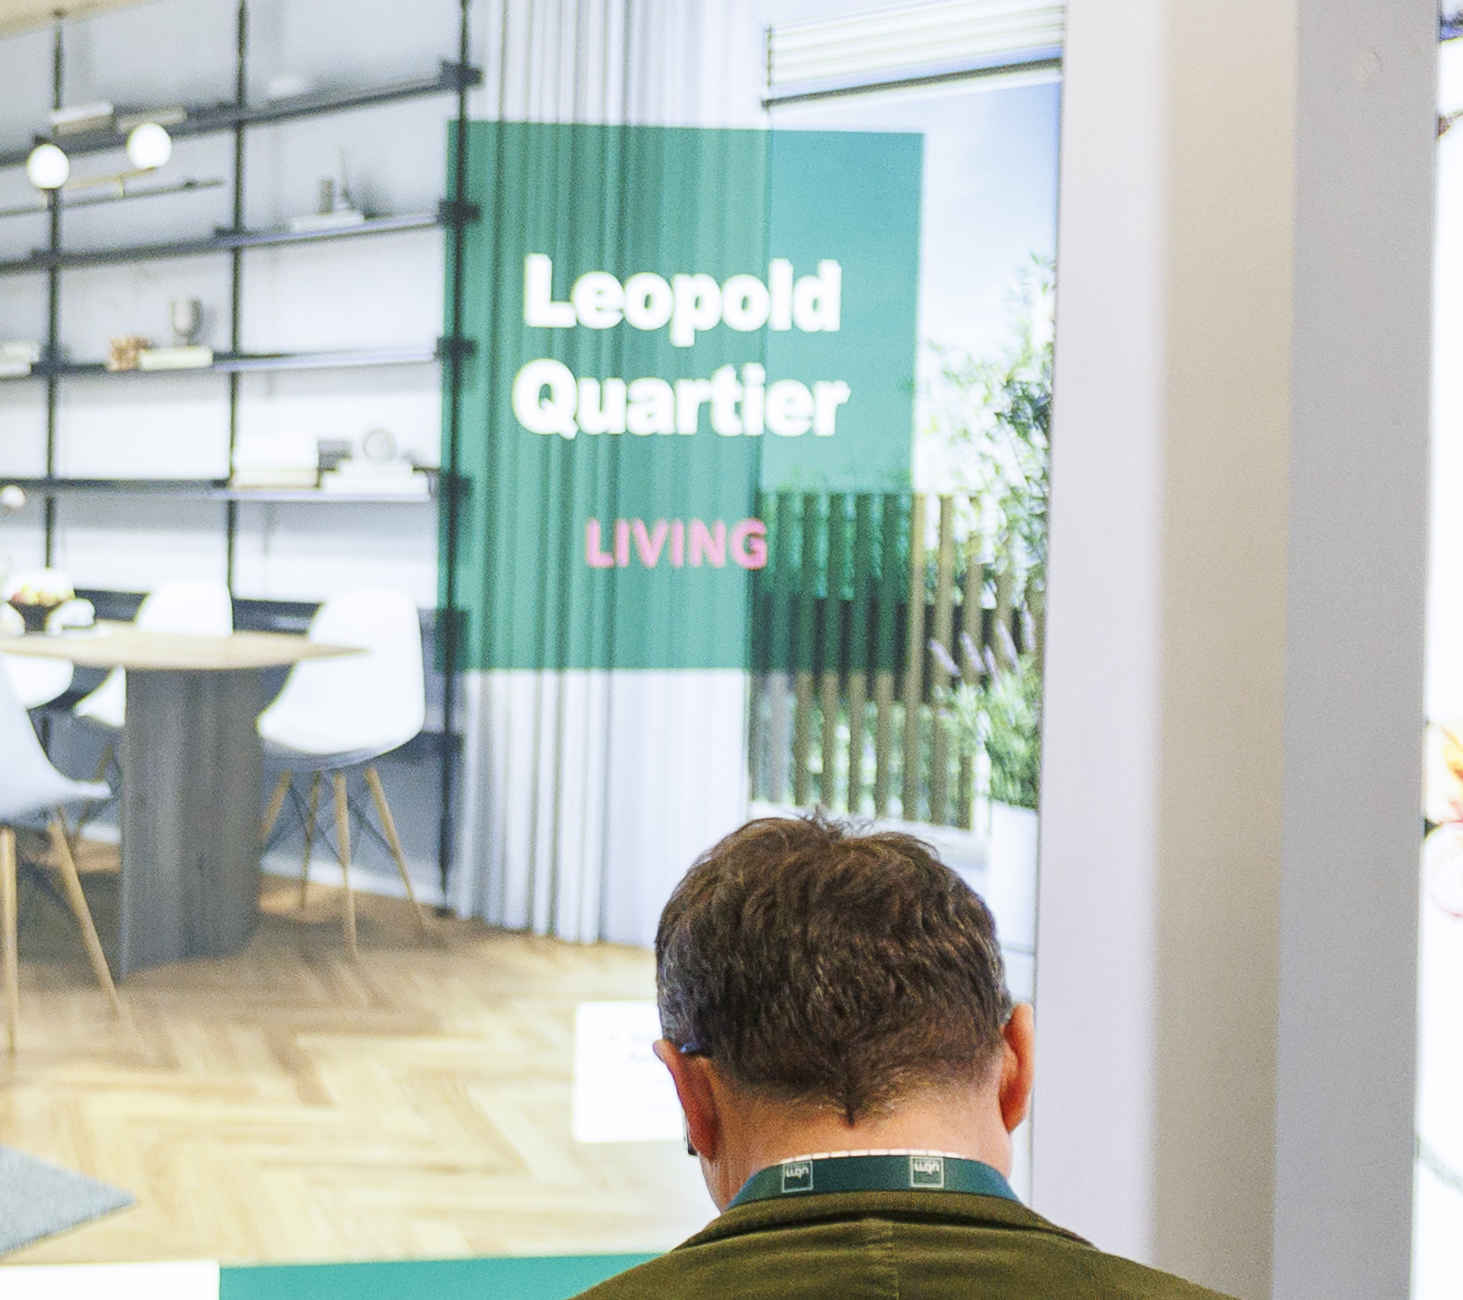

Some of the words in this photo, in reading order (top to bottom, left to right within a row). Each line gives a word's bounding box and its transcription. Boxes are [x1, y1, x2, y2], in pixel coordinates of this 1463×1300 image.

[522, 252, 843, 347] Leopold
[511, 357, 851, 439] Quartier
[585, 516, 769, 571] LIVING
